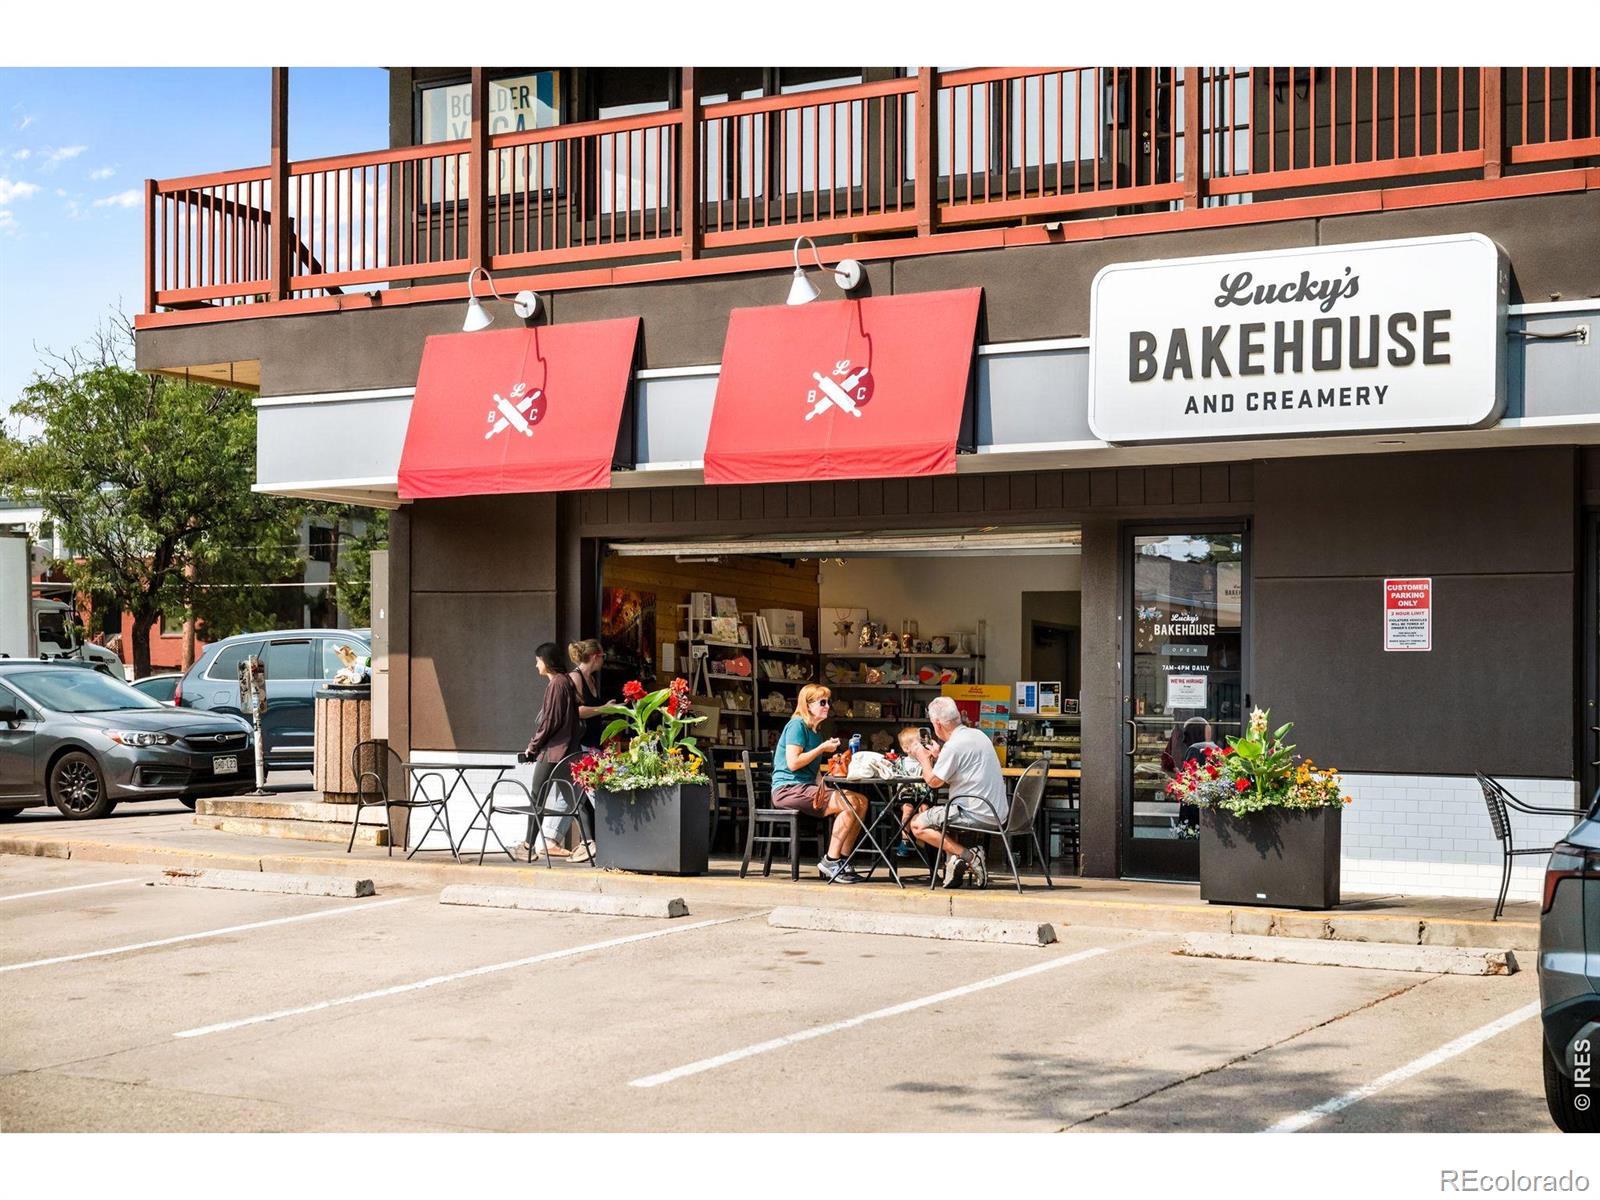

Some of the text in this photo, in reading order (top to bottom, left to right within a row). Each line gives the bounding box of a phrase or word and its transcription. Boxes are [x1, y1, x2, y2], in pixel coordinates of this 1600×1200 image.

[1214, 266, 1359, 313] Lucky's
[1128, 309, 1452, 383] BAKEHOUSE
[1184, 385, 1389, 415] AND CREAMERY
[1153, 623, 1216, 636] BAKEHOUSE
[1170, 613, 1199, 624] Lucky's
